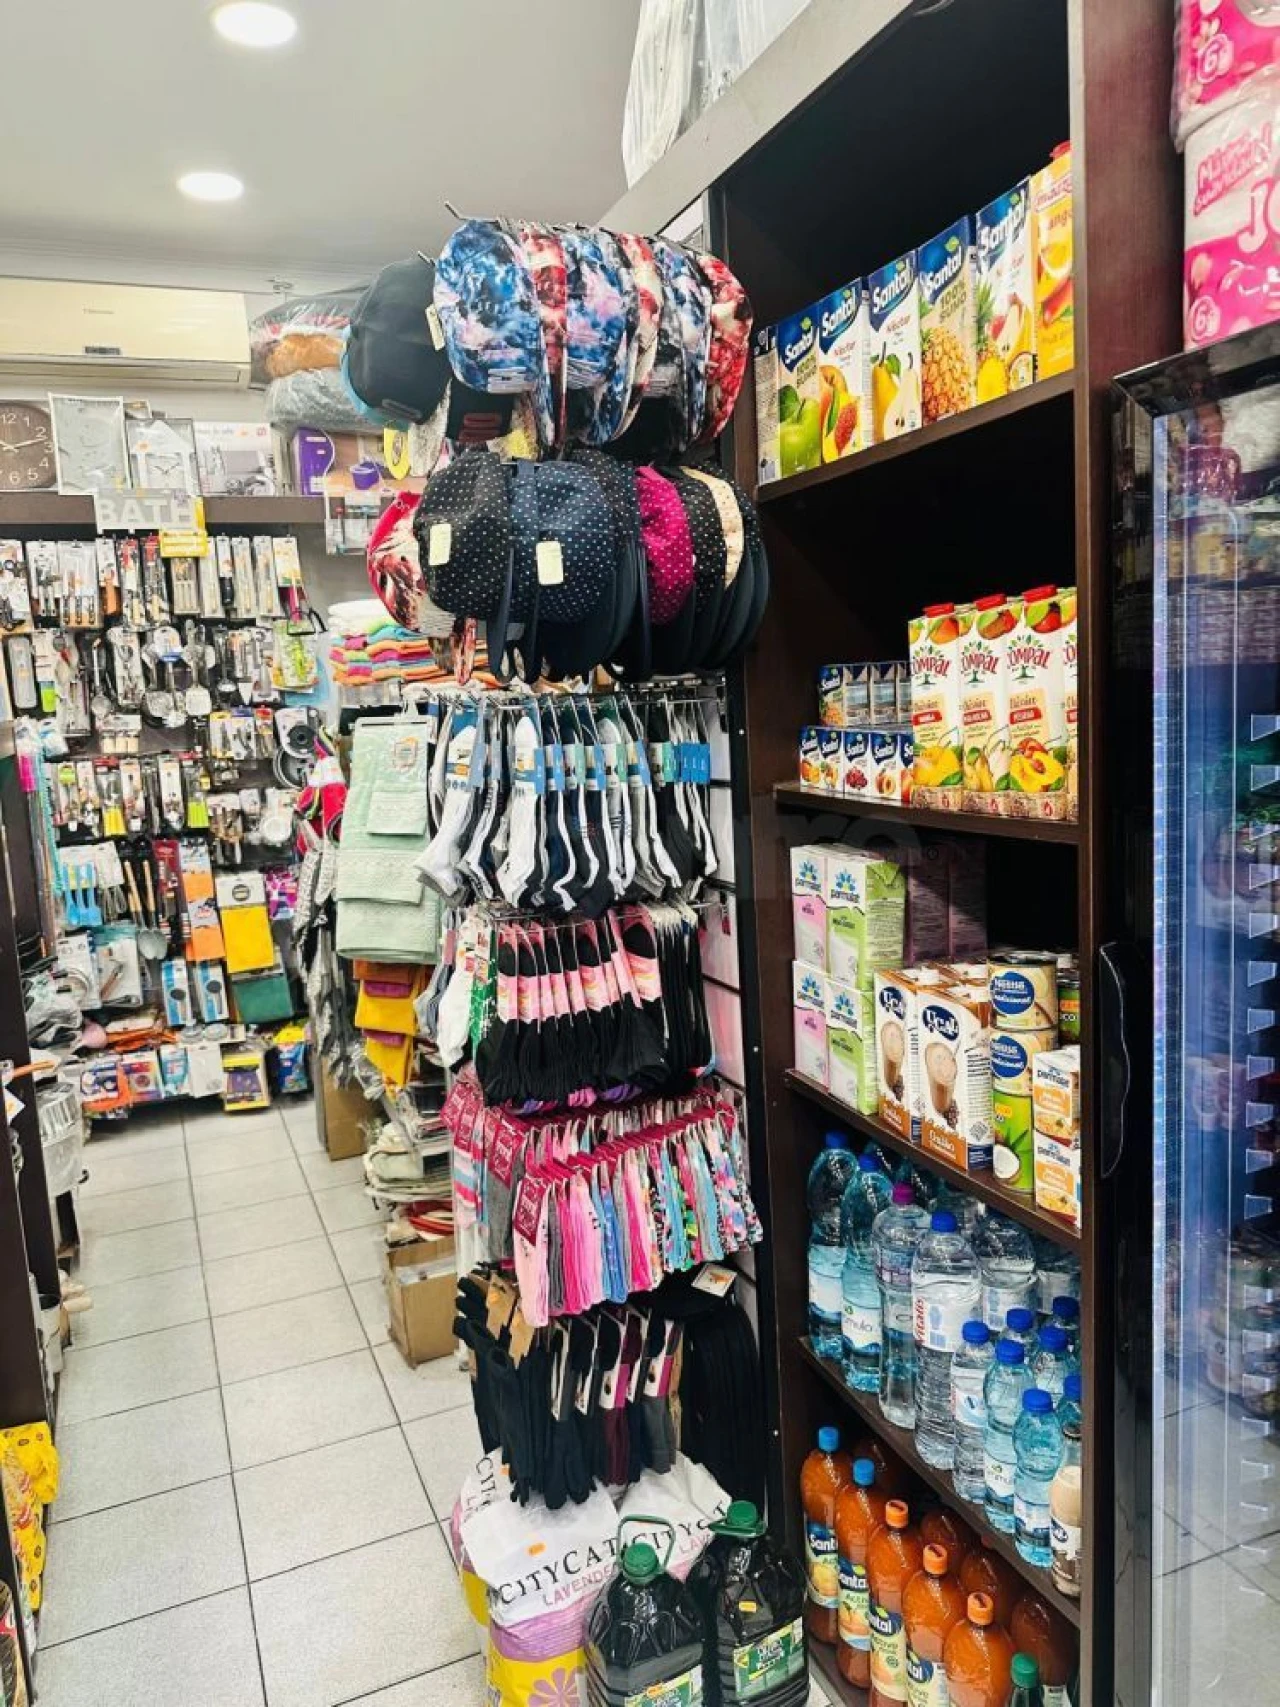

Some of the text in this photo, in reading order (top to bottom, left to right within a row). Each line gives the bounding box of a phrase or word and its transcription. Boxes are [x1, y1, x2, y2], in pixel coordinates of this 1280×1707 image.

[981, 188, 1025, 253] Santal
[927, 246, 962, 294] Santal
[873, 257, 911, 314] Santal
[822, 289, 857, 337] Santal
[785, 325, 814, 364] Santal
[2, 413, 16, 424] 12
[23, 416, 30, 428] 1
[35, 426, 48, 439] 2
[38, 457, 50, 469] 4
[9, 470, 21, 486] 6
[27, 467, 39, 480] 5
[809, 1533, 838, 1551] Sant
[500, 1537, 619, 1604] CITYCAT
[839, 1572, 869, 1589] anta
